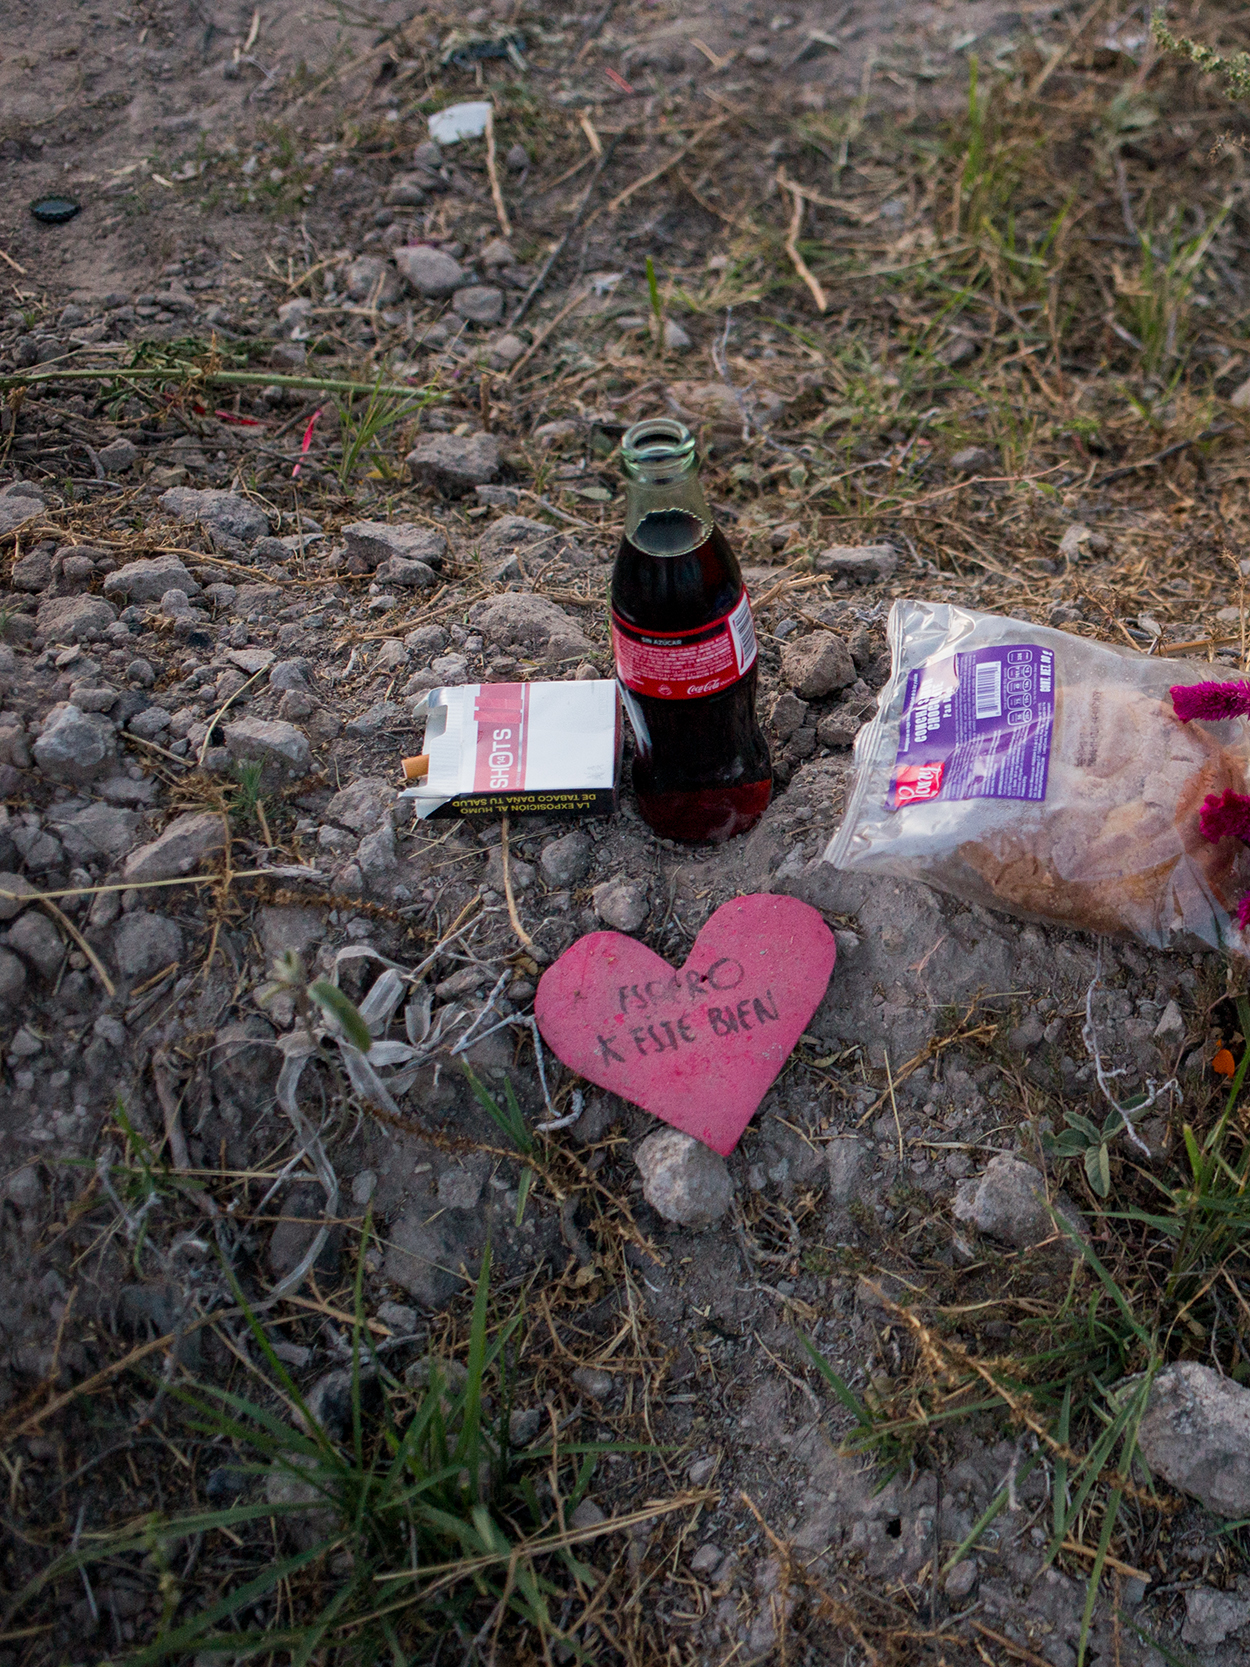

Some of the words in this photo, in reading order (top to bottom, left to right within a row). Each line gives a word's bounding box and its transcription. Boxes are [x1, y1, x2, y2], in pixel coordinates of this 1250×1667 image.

[641, 636, 652, 644] SIN
[914, 706, 928, 743] CONCHA
[488, 728, 514, 789] SHOTS
[898, 766, 942, 801] Pany
[489, 797, 504, 805] TU
[506, 795, 535, 805] DAÑA
[537, 794, 580, 803] TABACO
[582, 793, 596, 801] DE
[452, 798, 487, 808] SALUD
[518, 802, 574, 813] EXPOSICIÓN
[460, 806, 493, 815] HUMO
[495, 805, 509, 813] AL
[707, 989, 780, 1037] BIEN
